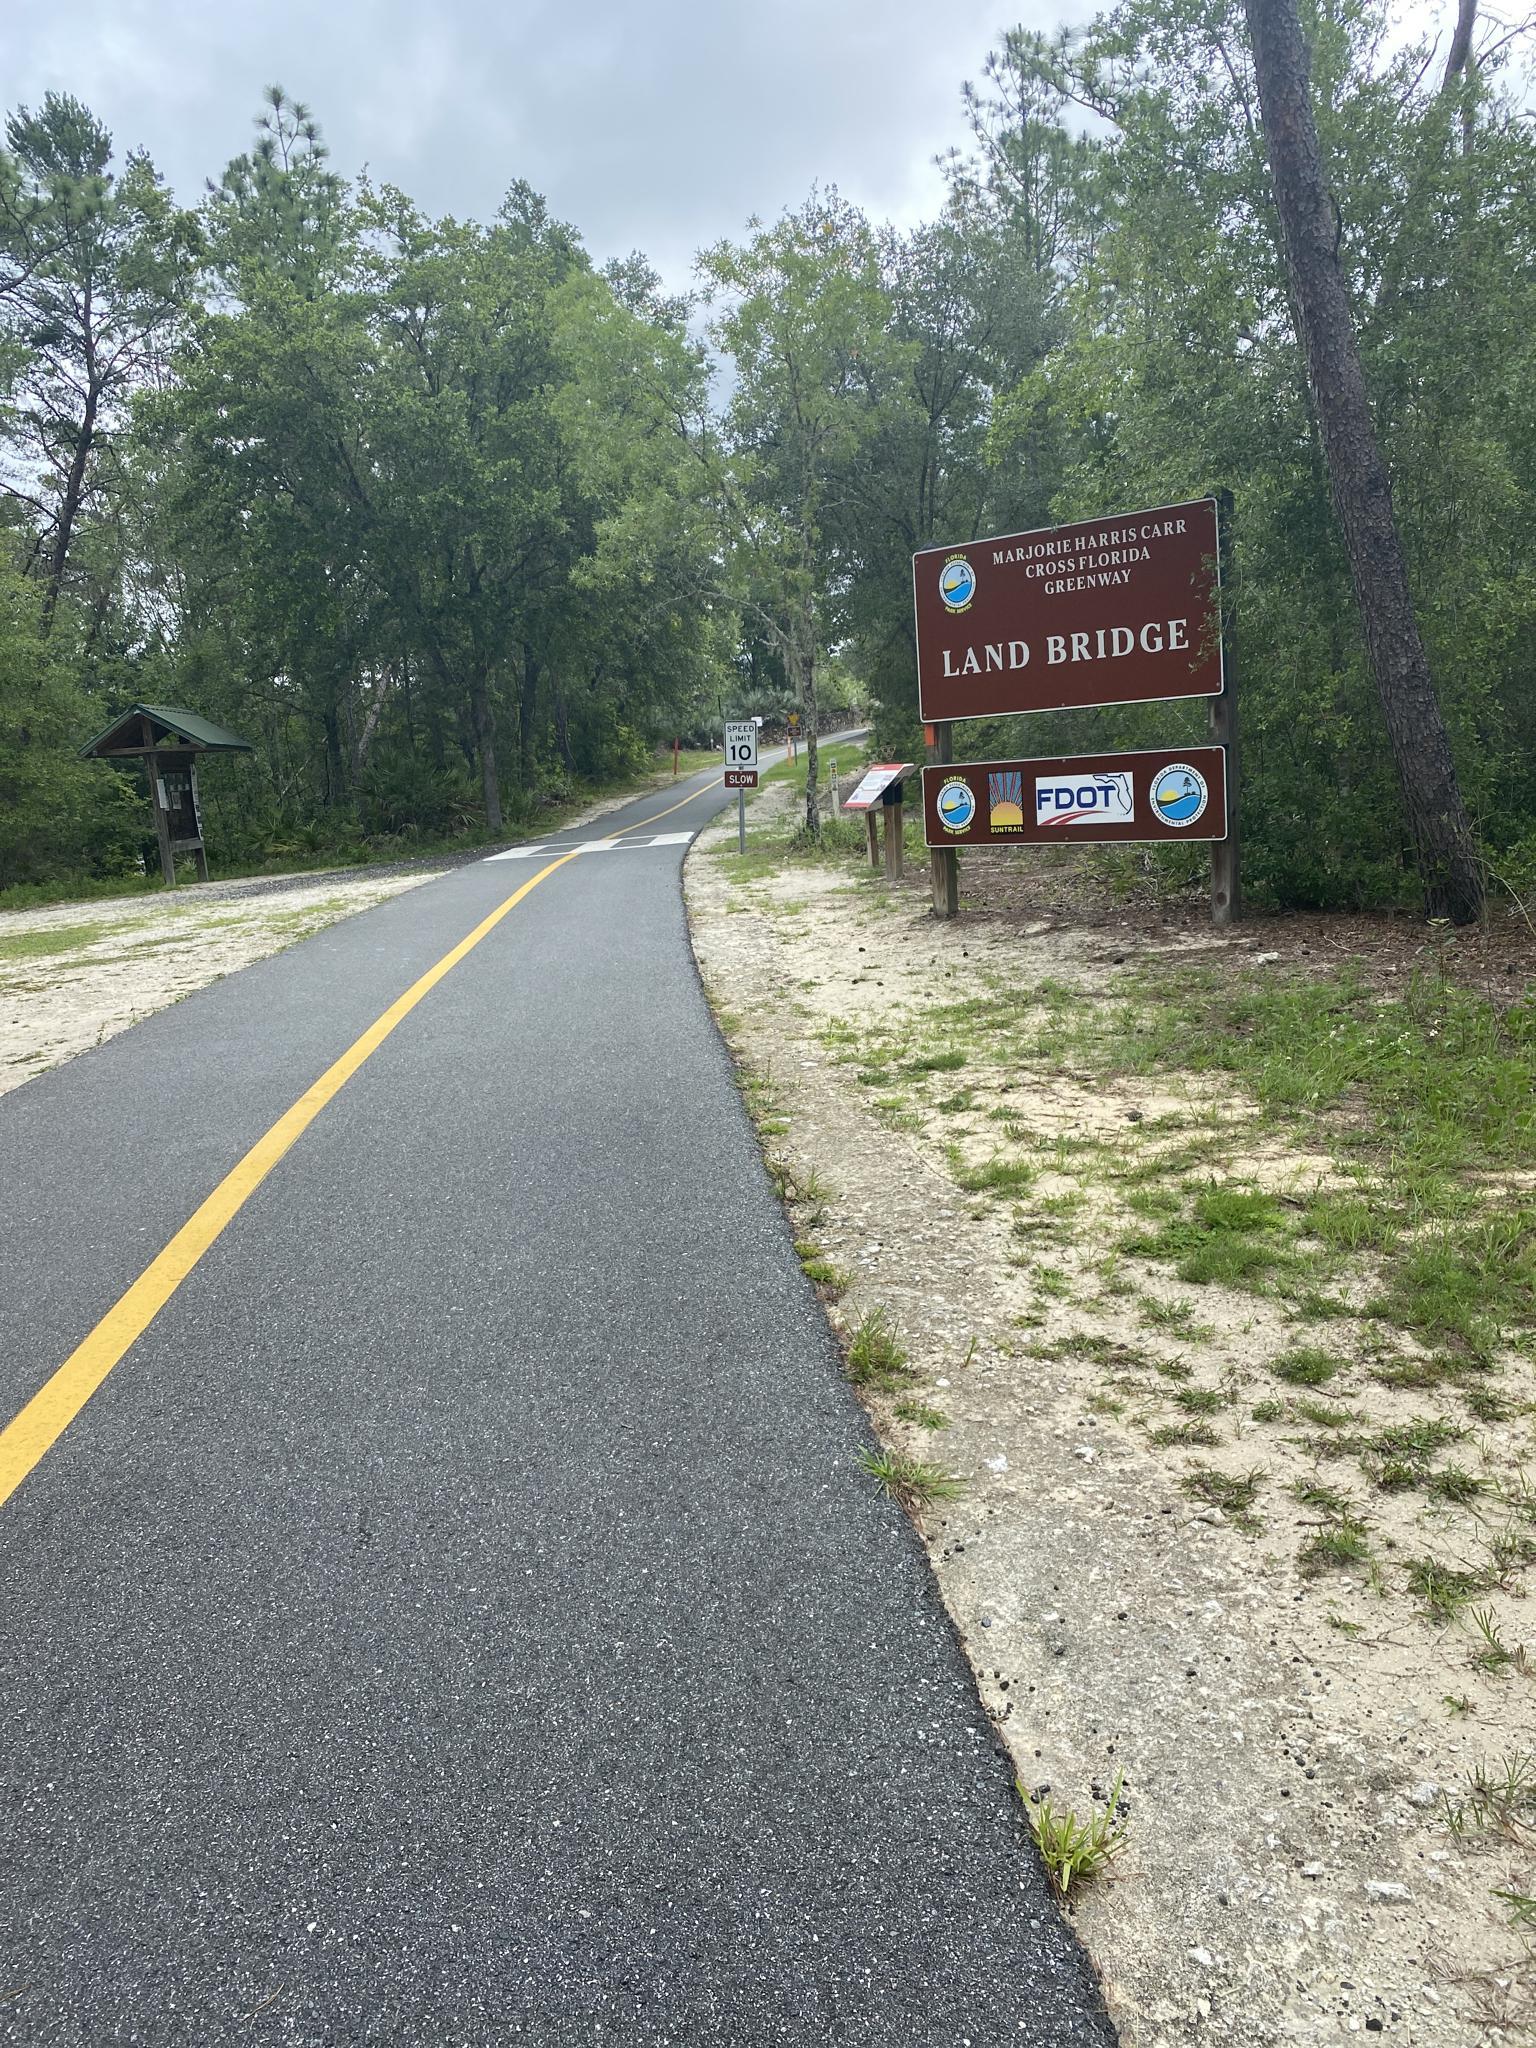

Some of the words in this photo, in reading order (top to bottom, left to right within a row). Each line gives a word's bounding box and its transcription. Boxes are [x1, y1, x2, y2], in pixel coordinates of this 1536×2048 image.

[993, 539, 1072, 565] MARJORIE
[1075, 527, 1137, 551] HARRIS
[1141, 519, 1187, 540] CARR
[1025, 559, 1076, 579] CROSS
[1079, 546, 1151, 571] FLORIDA
[1044, 568, 1132, 595] GREENWAY
[942, 639, 1030, 678] LAND
[1046, 618, 1190, 665] BRIDGE
[726, 725, 755, 733] SPEED
[730, 744, 752, 761] 10
[729, 774, 754, 785] SLOW
[943, 775, 967, 785] FLORIDA
[1037, 785, 1116, 810] FDOT
[990, 825, 1024, 834] SUNTRAIL
